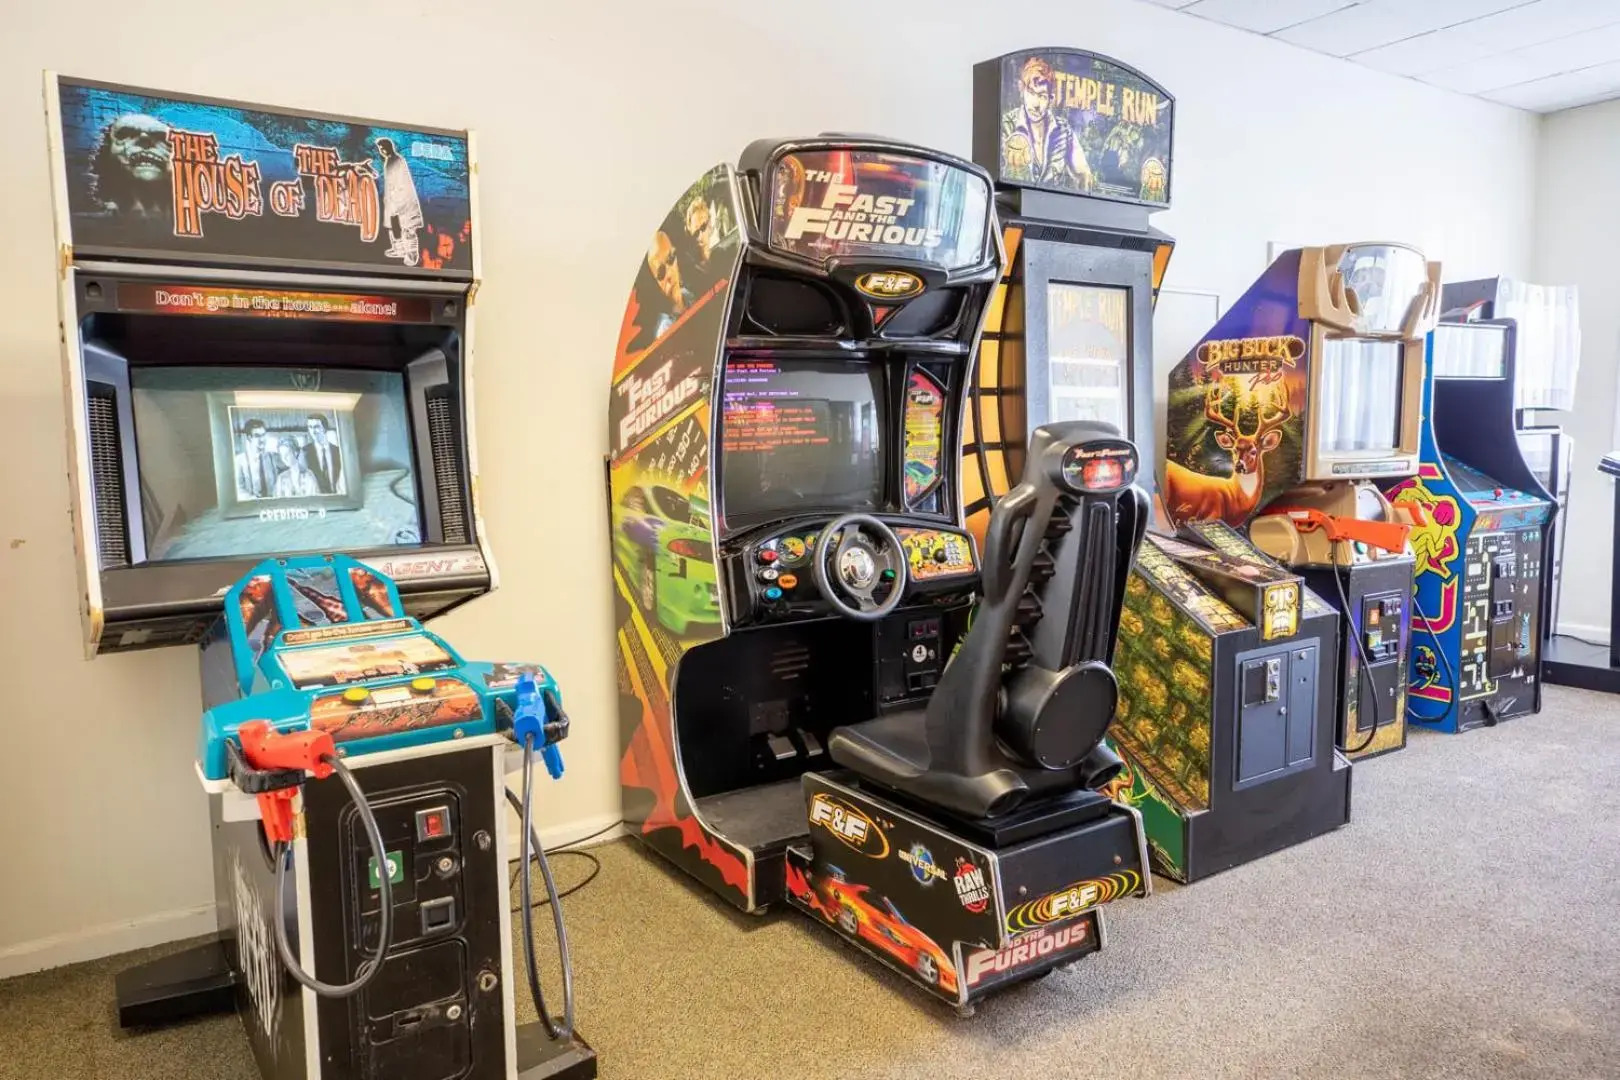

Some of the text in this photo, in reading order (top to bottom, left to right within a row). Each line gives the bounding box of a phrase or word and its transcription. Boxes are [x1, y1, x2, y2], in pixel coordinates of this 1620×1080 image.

[1053, 71, 1158, 125] TEMPLE RUN
[168, 130, 219, 164] THE
[294, 143, 340, 177] THE
[411, 141, 454, 161] SEGA
[804, 169, 844, 184] THE
[171, 152, 306, 238] HOUSE OF
[315, 172, 380, 243] DEAD
[832, 210, 897, 225] AND THE
[865, 271, 914, 293] F&F
[155, 290, 204, 306] Don't
[207, 295, 230, 311] go
[232, 295, 250, 309] in
[252, 296, 280, 310] the
[1207, 335, 1297, 372] BIG BUCK
[1224, 360, 1277, 372] HUNTER
[618, 374, 635, 397] THE
[811, 799, 868, 841] F&F
[898, 849, 948, 881] UNIVERSAL
[953, 867, 984, 896] RAW
[959, 887, 989, 908] THRILLS
[1051, 885, 1097, 916] F&F
